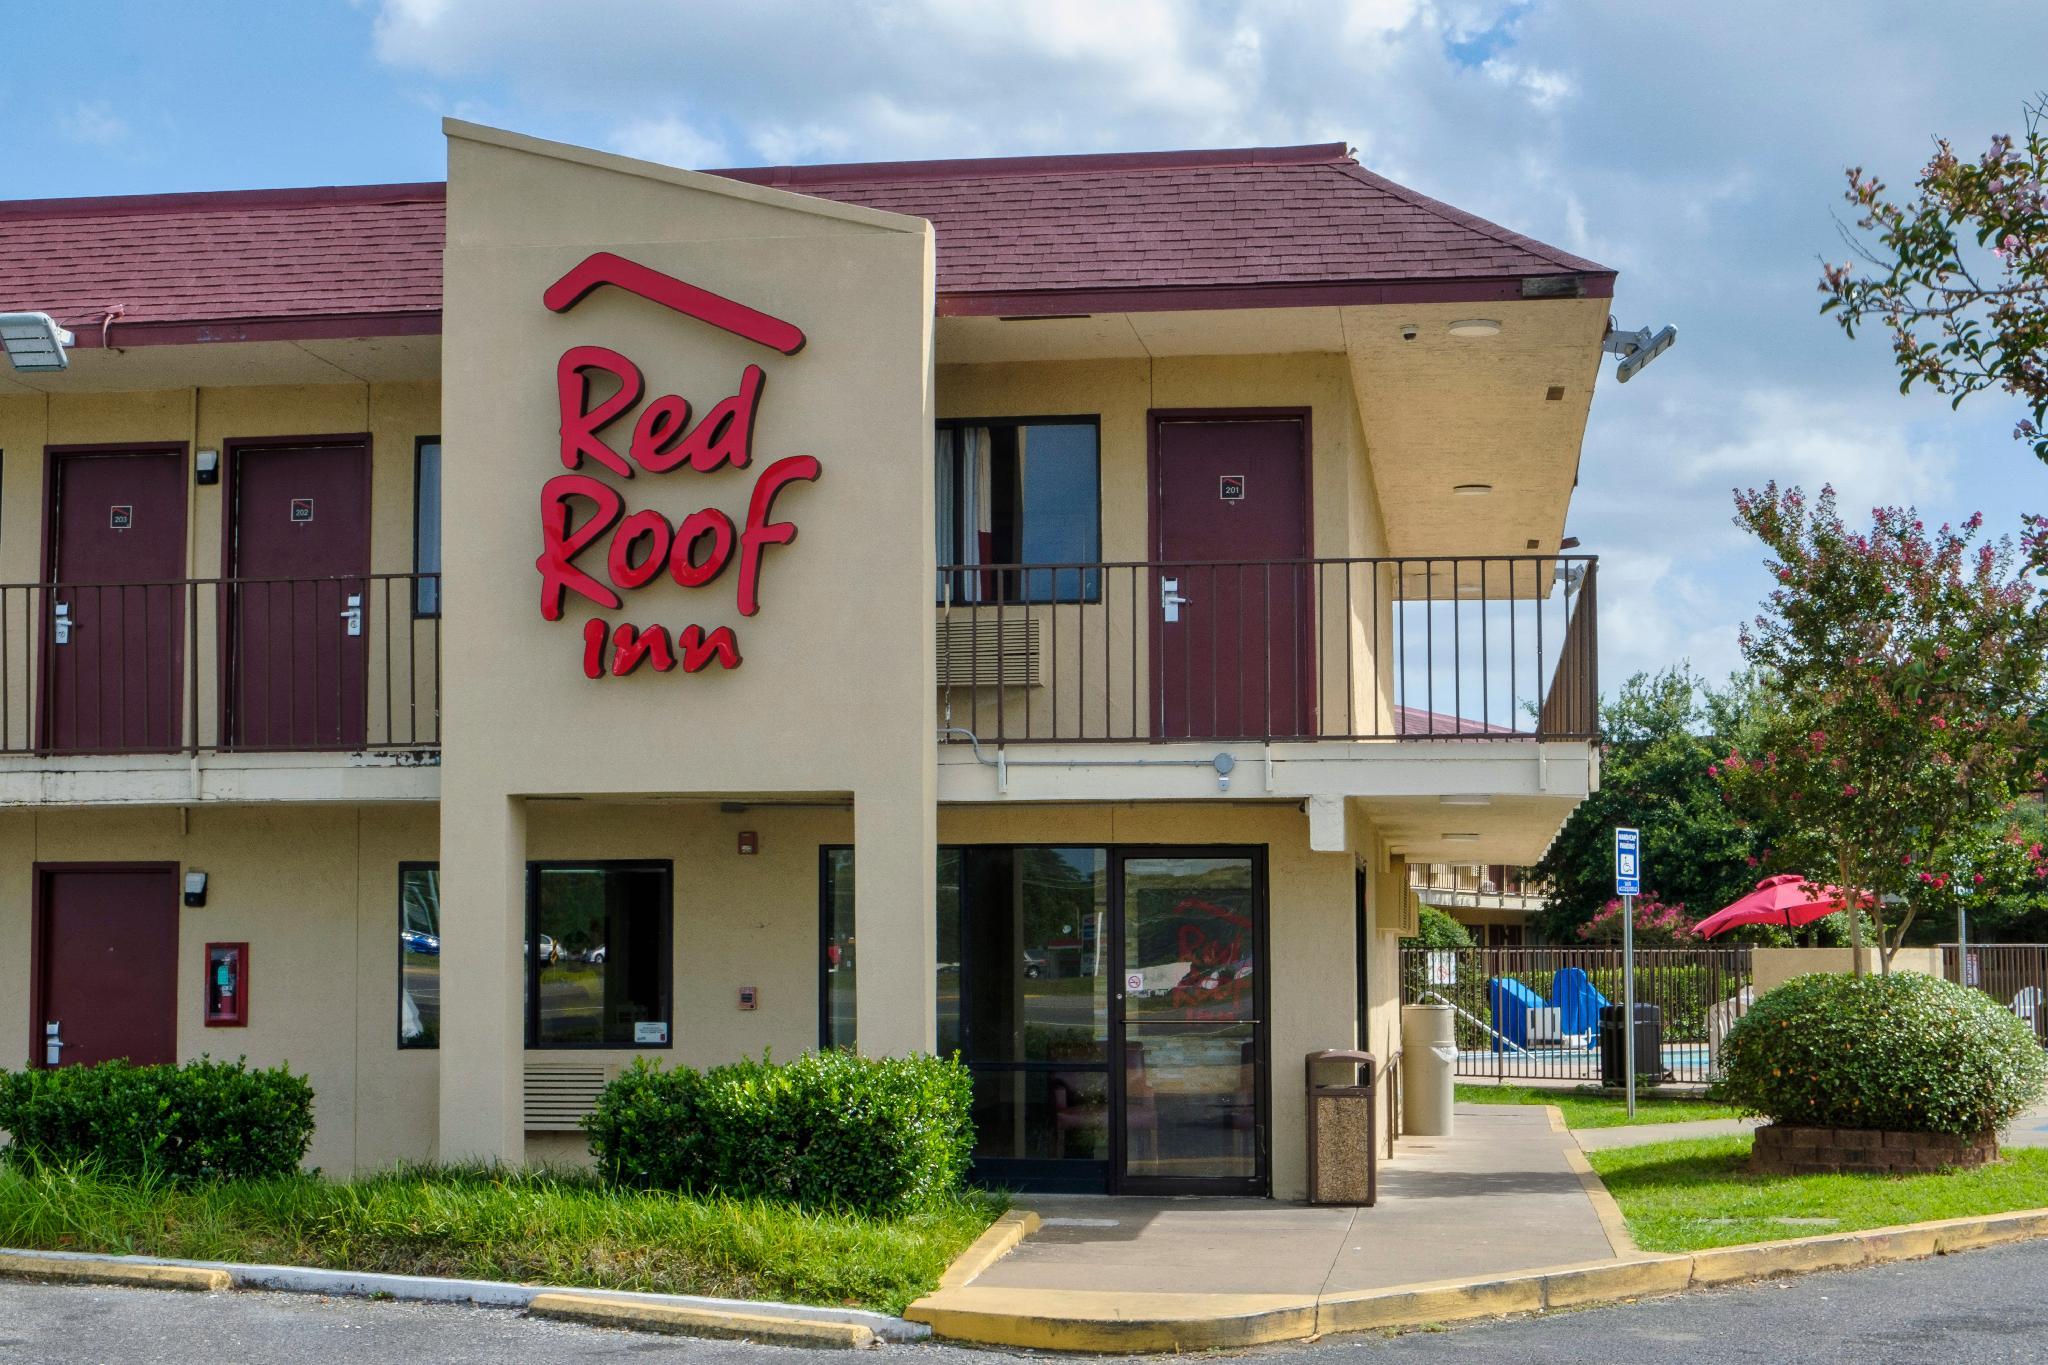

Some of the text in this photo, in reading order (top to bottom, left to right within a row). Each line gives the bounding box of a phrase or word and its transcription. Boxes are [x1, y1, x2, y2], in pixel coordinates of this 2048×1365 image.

[557, 346, 766, 479] Red
[536, 455, 822, 621] Roof
[1225, 486, 1239, 494] 201
